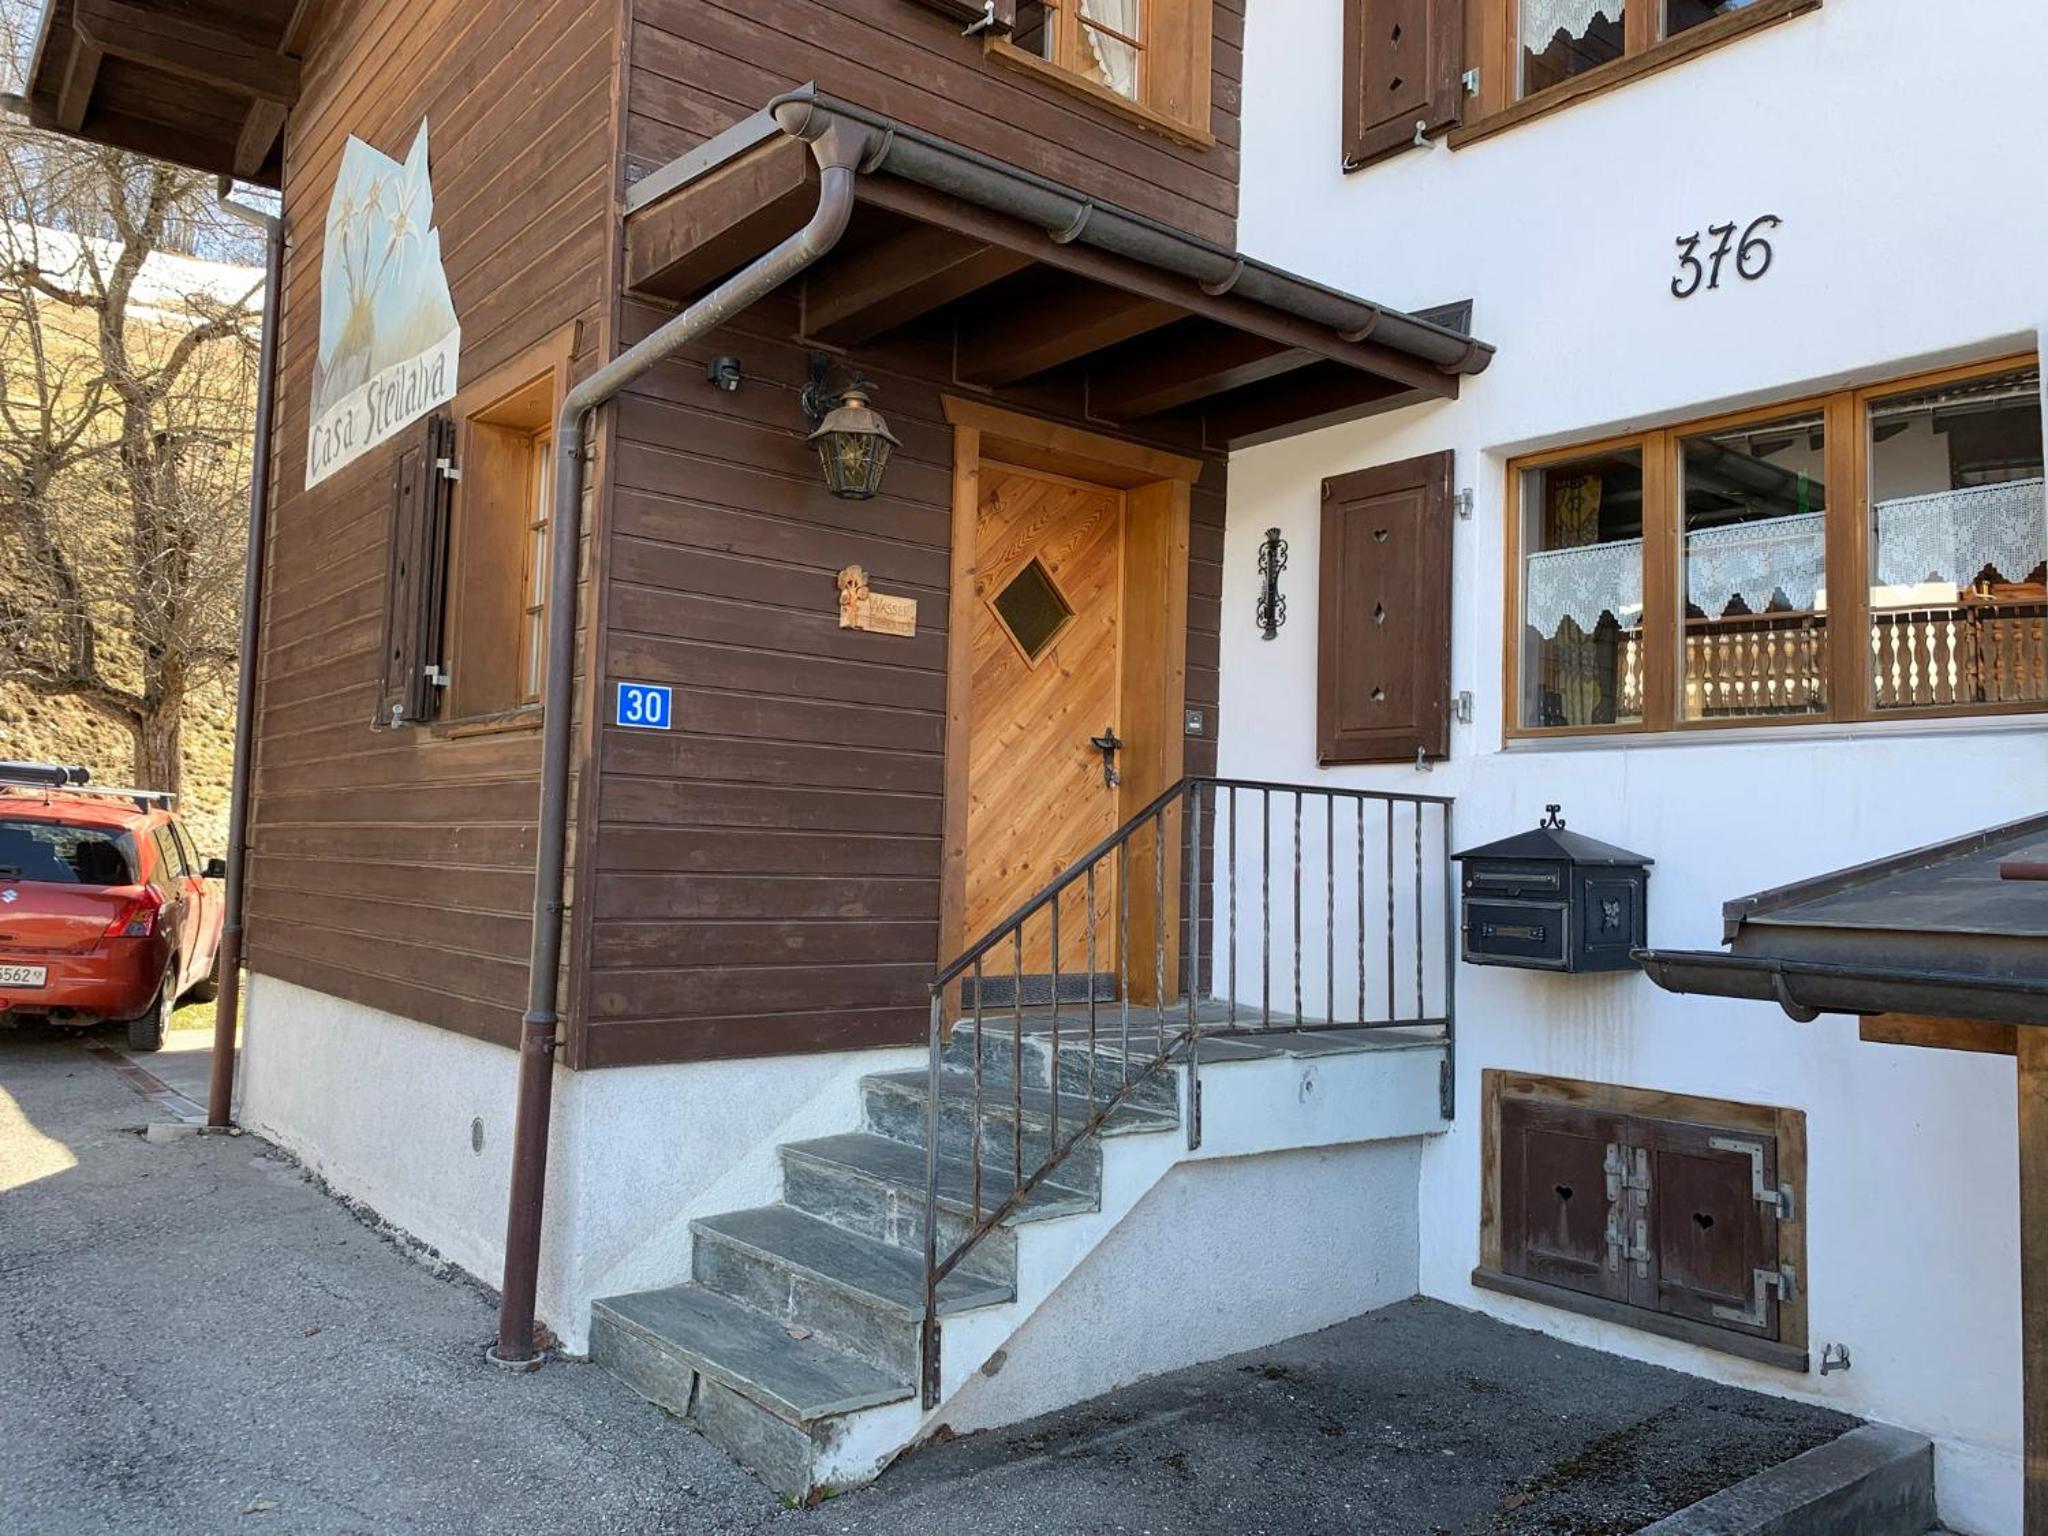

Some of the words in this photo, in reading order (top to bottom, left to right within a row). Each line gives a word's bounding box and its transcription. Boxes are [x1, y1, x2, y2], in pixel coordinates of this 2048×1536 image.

[1671, 214, 1783, 299] 376
[311, 407, 354, 478] Casa
[626, 689, 662, 723] 30
